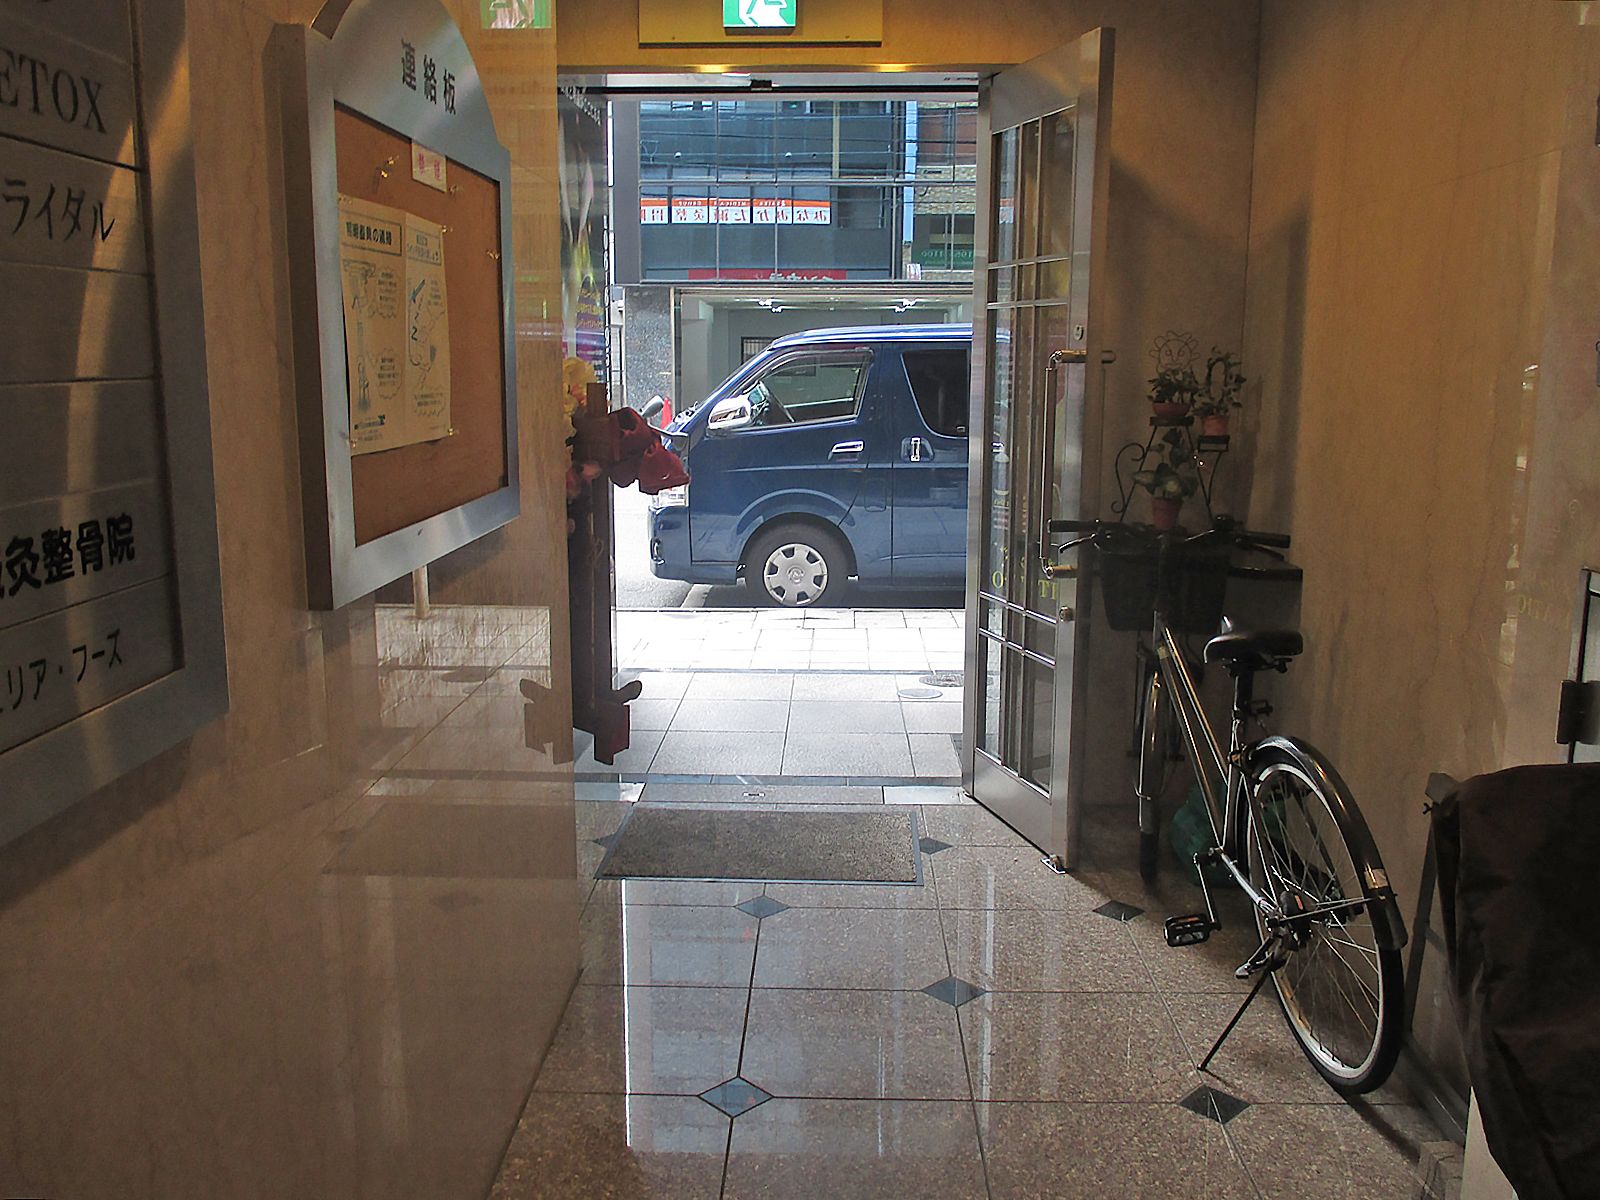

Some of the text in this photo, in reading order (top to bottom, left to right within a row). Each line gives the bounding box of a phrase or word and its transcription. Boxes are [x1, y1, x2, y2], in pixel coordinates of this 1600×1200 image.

[401, 38, 457, 115] 連絡板
[0, 511, 136, 600] 灸整骨院
